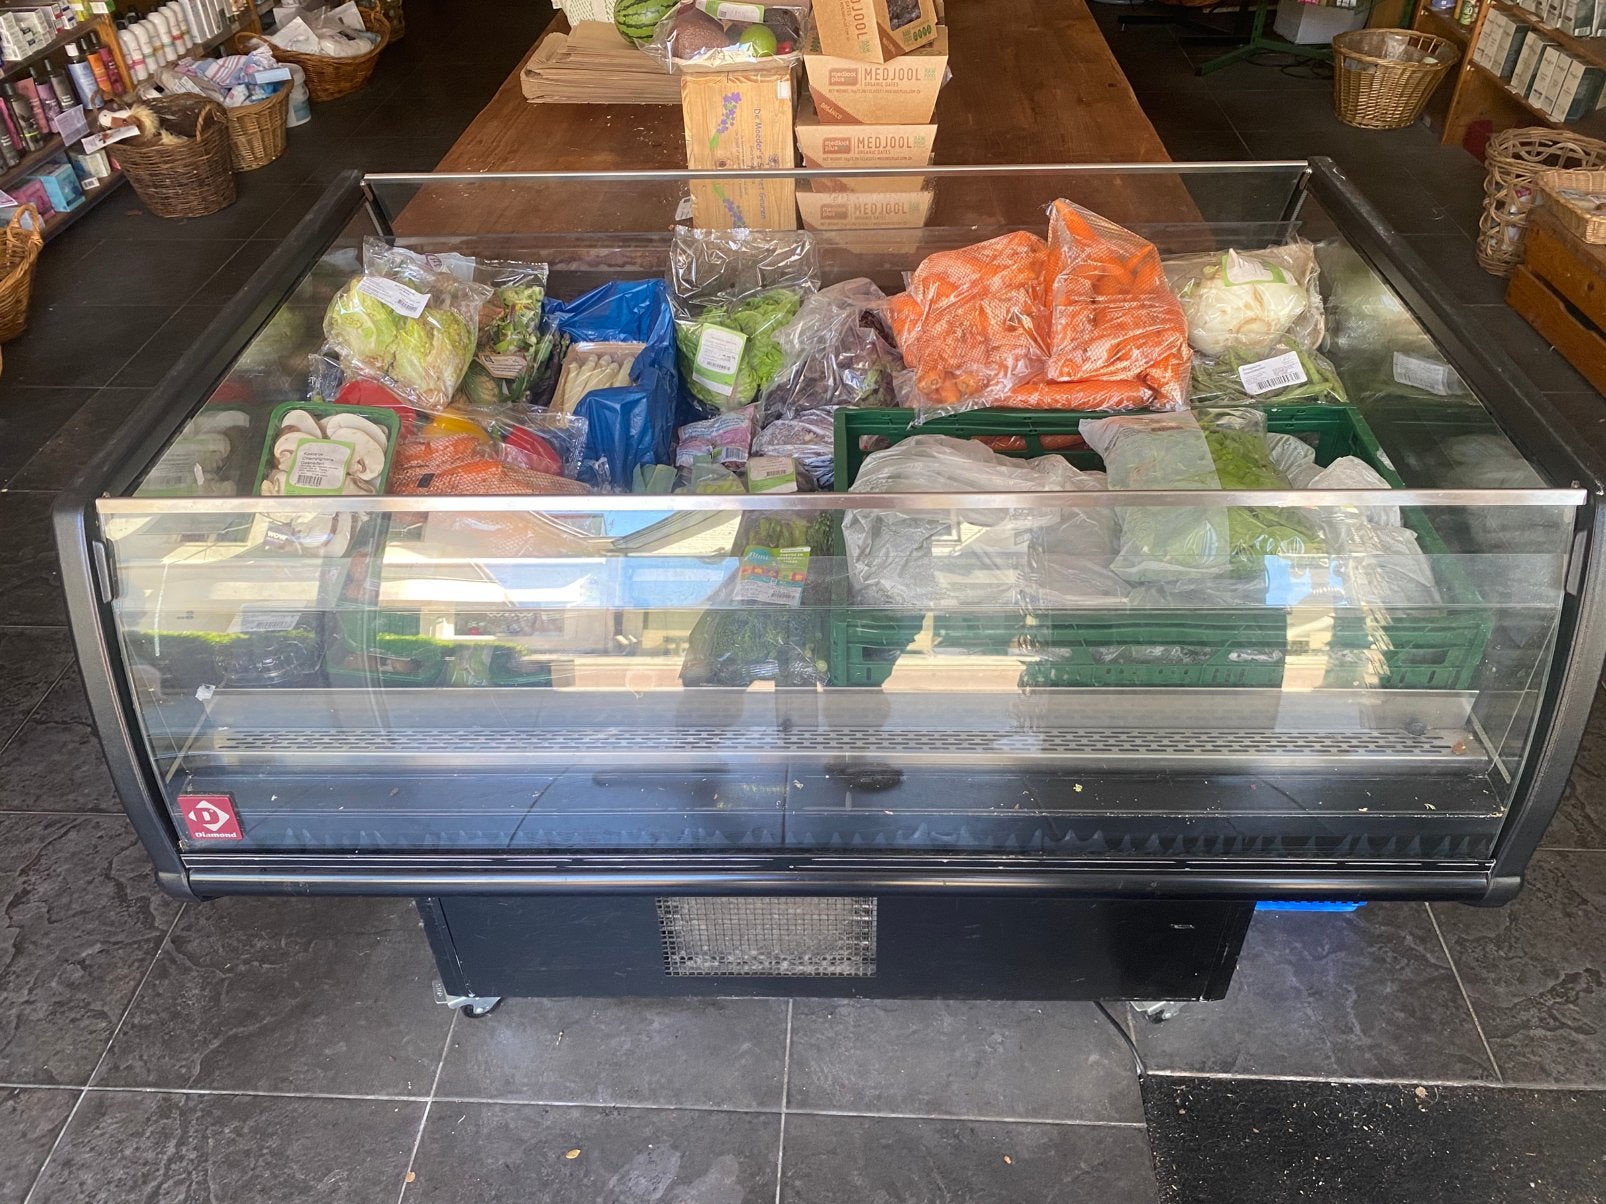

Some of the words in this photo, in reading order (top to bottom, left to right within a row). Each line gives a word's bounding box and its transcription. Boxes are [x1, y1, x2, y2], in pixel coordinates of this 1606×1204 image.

[864, 67, 921, 81] MEDJOOL
[857, 136, 912, 149] MEDJOOL
[854, 202, 908, 215] MEDJOOL
